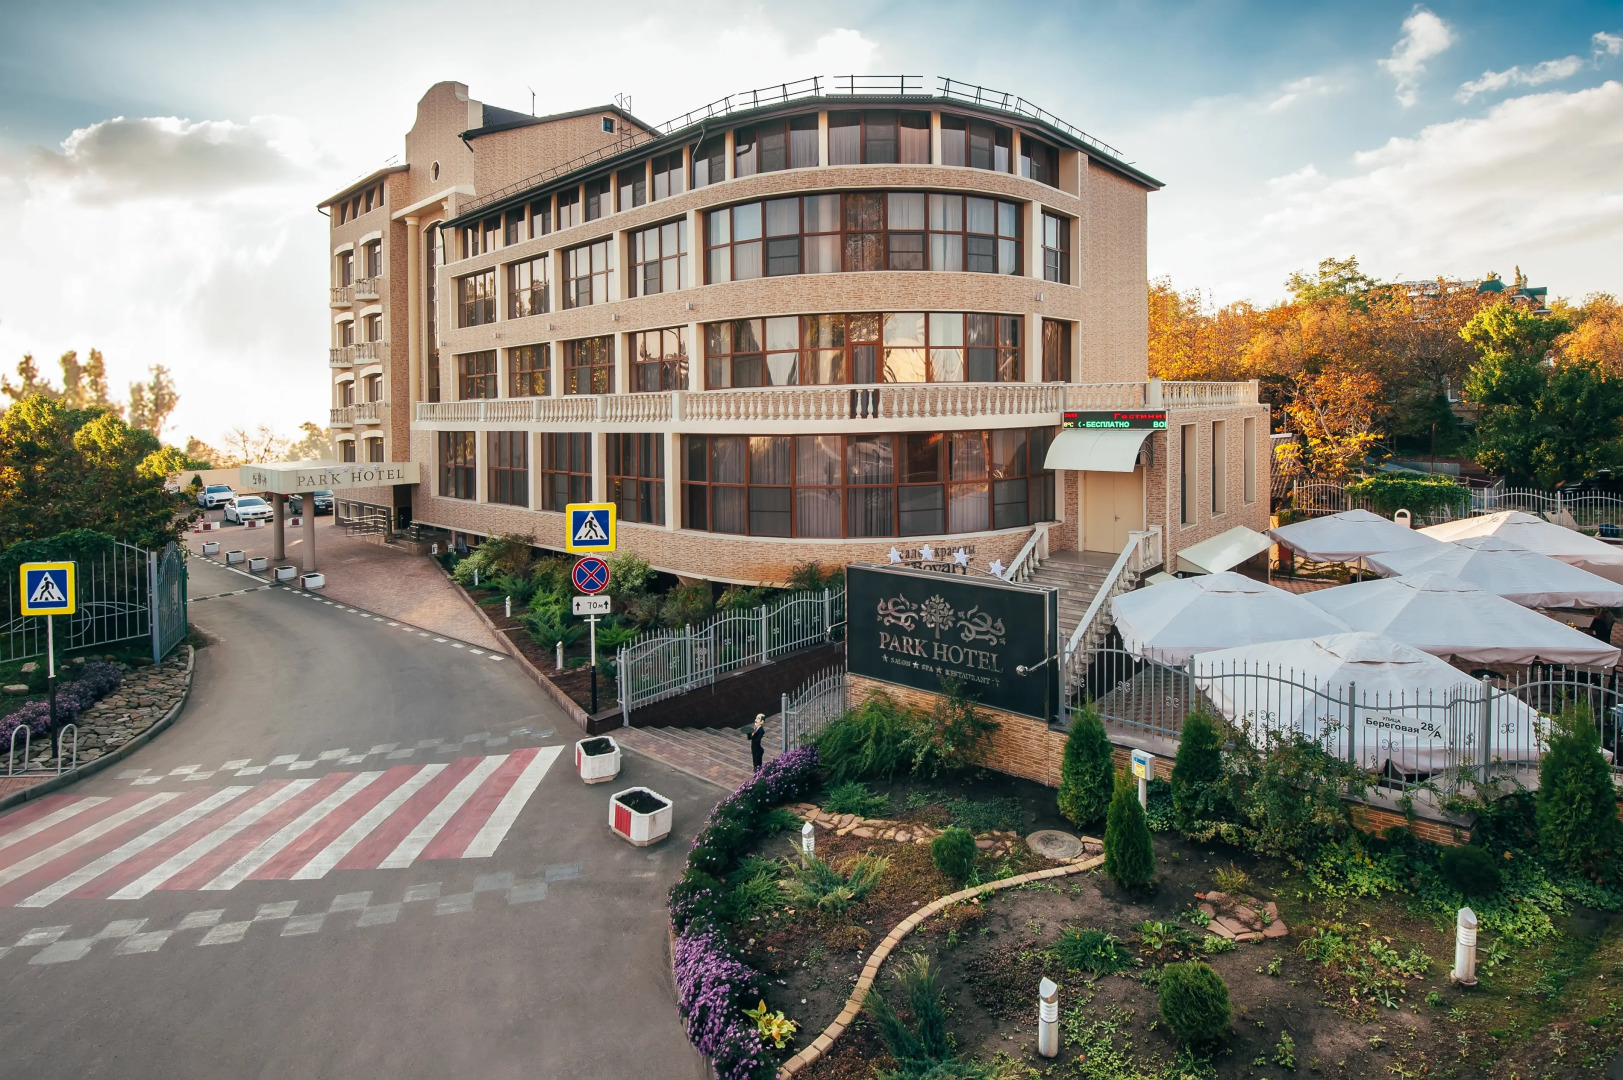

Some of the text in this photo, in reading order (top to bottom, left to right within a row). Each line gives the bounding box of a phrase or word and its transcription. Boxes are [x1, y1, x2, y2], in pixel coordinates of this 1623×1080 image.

[297, 469, 405, 487] PARK HOTEL
[879, 631, 1004, 674] PARK HOTEL
[890, 657, 912, 667] SALON
[921, 663, 934, 673] SPA
[1365, 717, 1420, 734] Береговая
